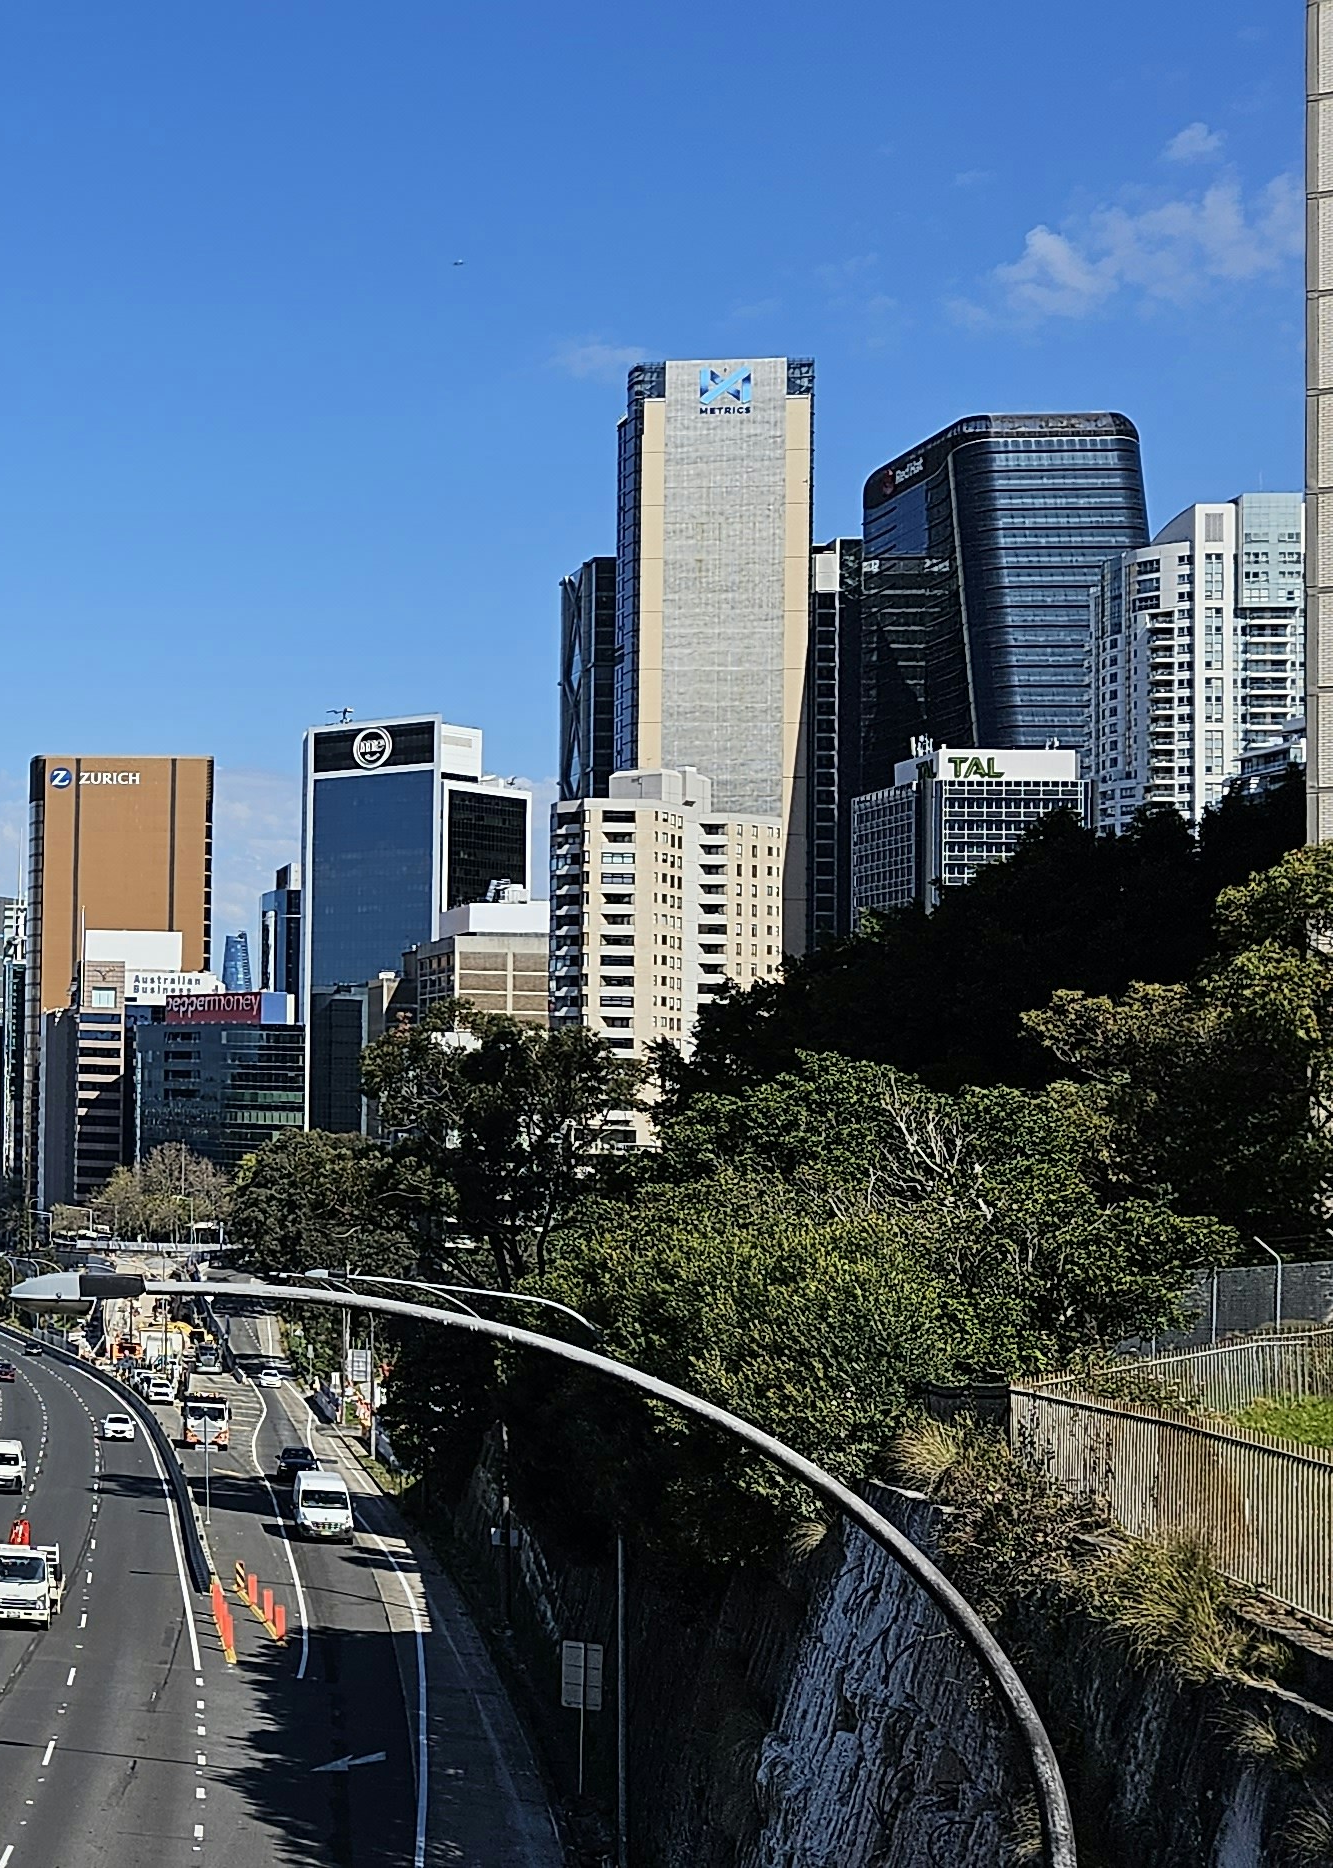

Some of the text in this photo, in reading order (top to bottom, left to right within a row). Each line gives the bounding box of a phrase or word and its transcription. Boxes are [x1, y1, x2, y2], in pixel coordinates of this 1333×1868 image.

[699, 406, 751, 415] METRICS
[359, 739, 386, 752] me
[948, 757, 1005, 778] TAL
[79, 771, 141, 785] ZURICH
[133, 974, 201, 986] Australian
[133, 985, 192, 994] Business
